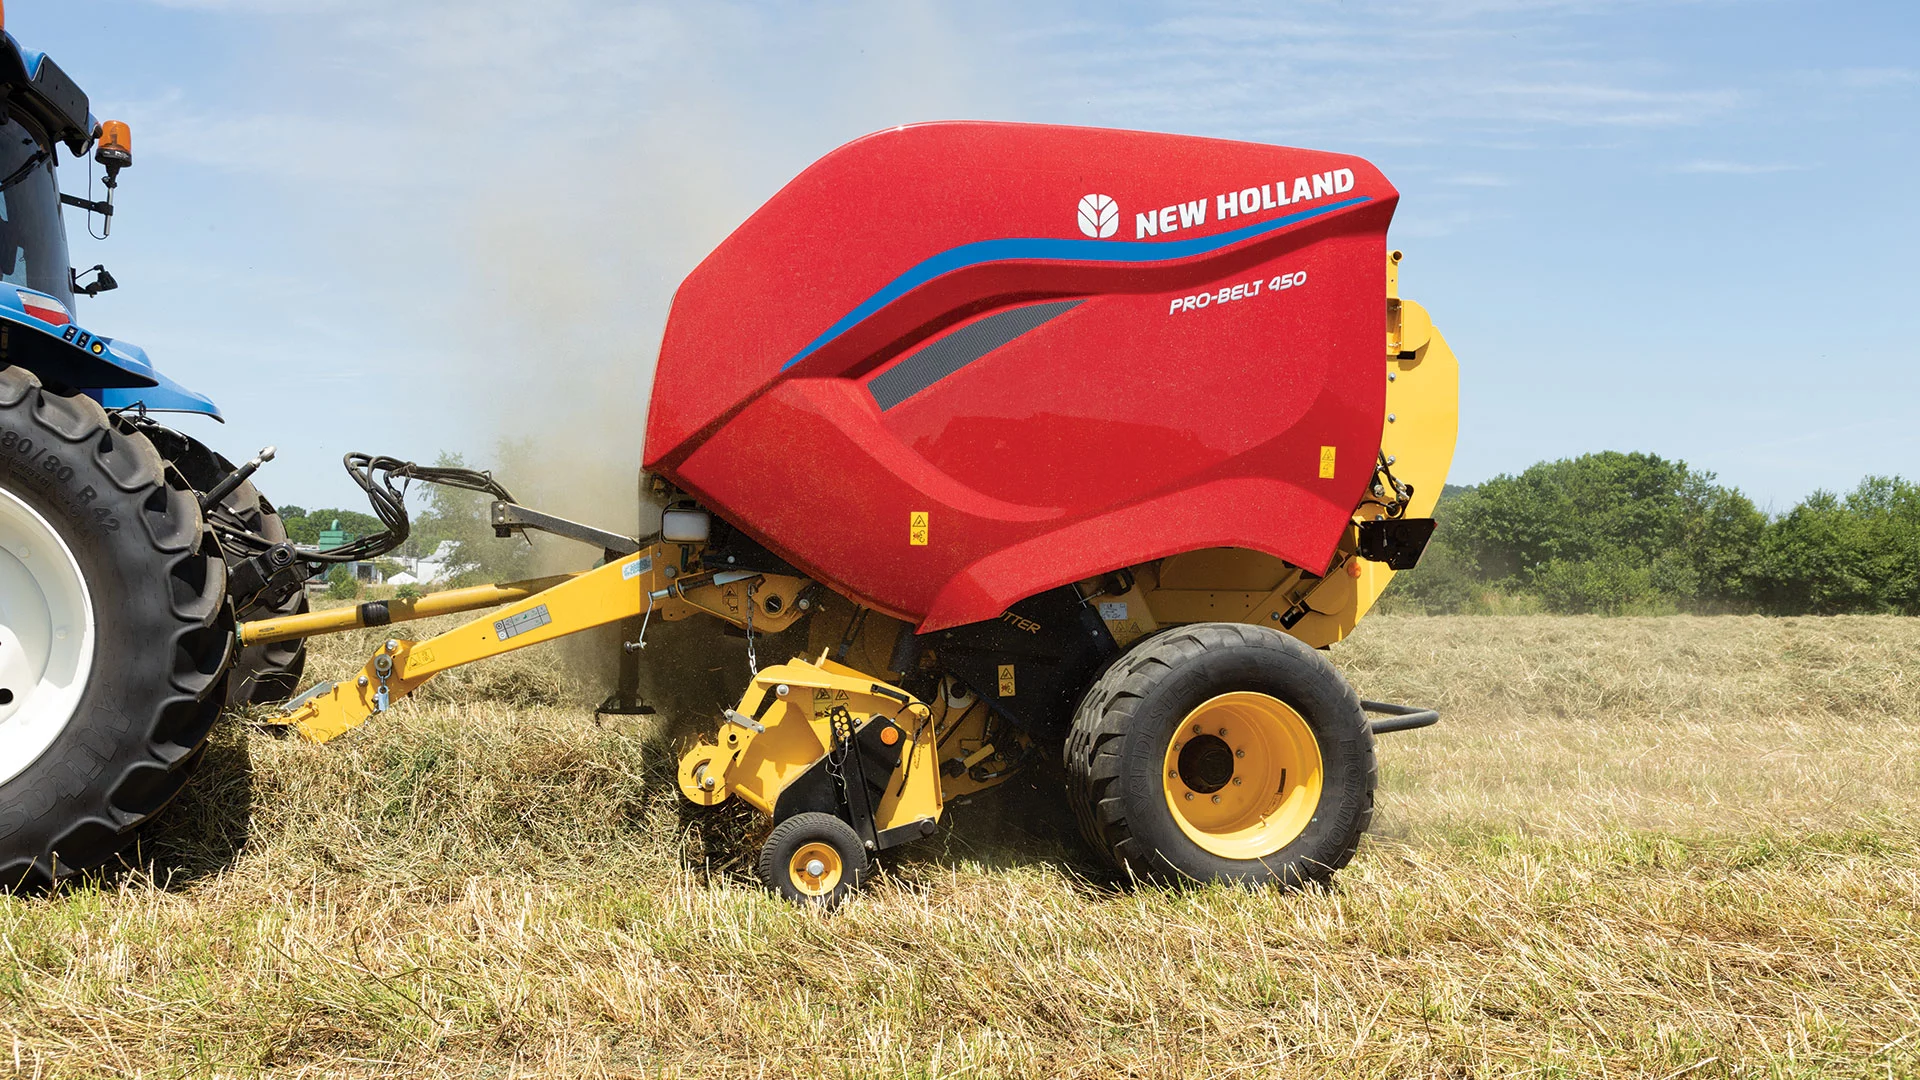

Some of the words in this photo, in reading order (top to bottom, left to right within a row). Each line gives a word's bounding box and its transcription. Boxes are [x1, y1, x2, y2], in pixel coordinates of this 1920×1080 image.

[1136, 198, 1208, 239] NEW
[1216, 168, 1355, 220] HOLLAND
[1169, 279, 1263, 315] PRO-BELT
[1268, 271, 1307, 293] 450
[0, 426, 74, 484] 80/80
[94, 507, 121, 536] 42
